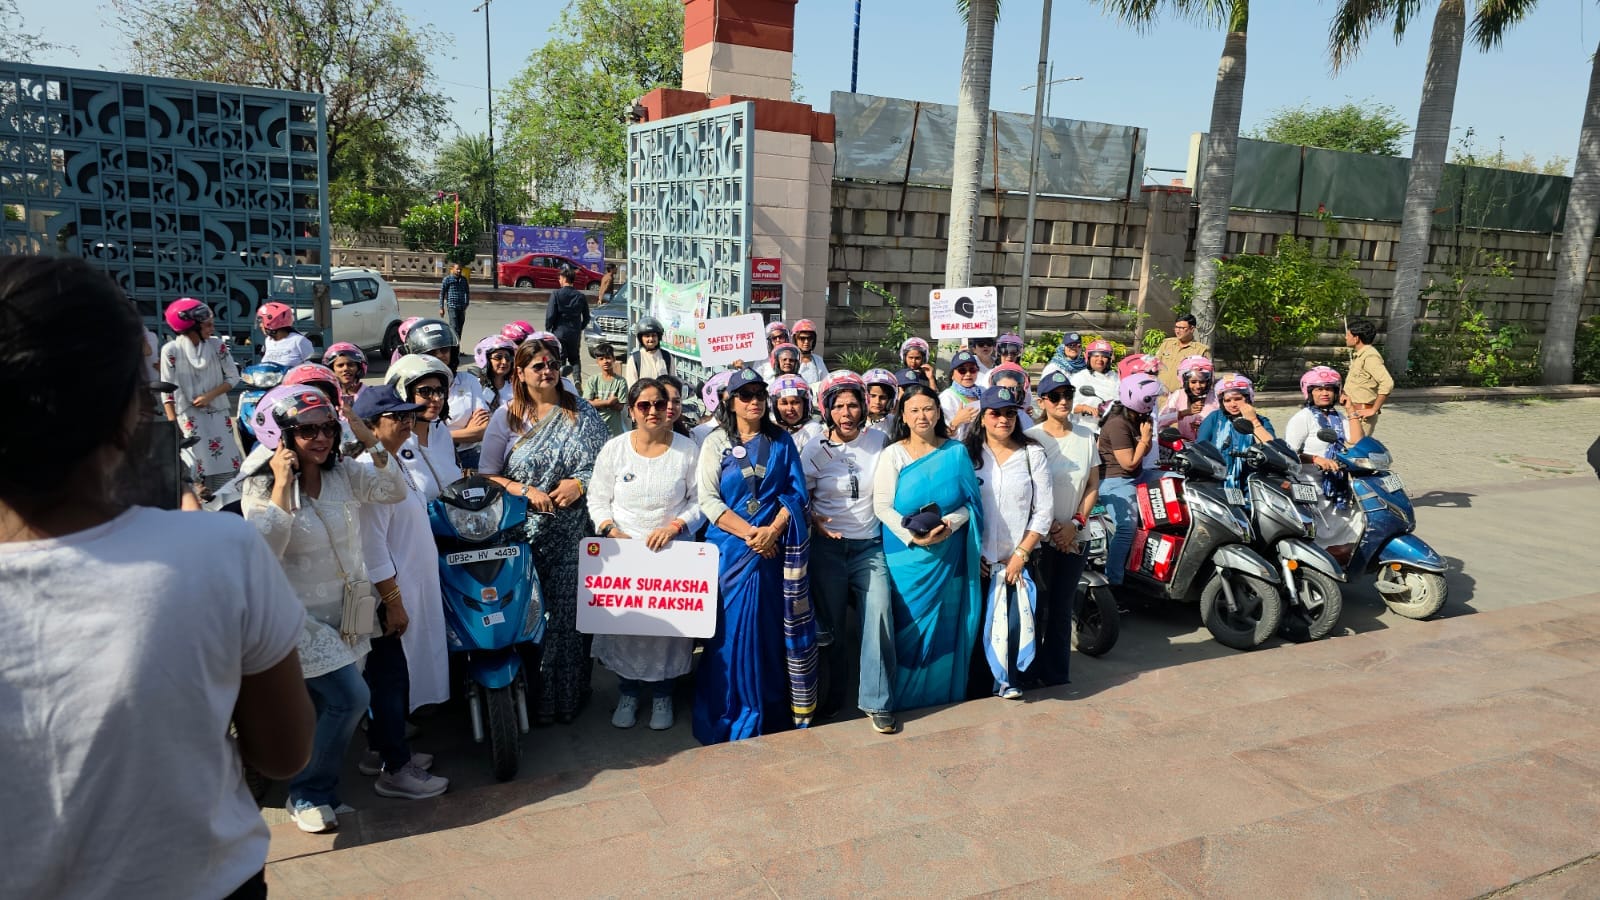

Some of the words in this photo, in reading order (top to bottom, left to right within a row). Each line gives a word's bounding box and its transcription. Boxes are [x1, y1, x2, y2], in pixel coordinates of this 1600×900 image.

[962, 322, 987, 330] HELMET
[707, 335, 733, 344] SAFETY
[735, 332, 754, 340] FIRST
[712, 344, 733, 352] SPEED
[735, 341, 753, 349] LAST
[1149, 488, 1167, 519] STUDDS
[478, 551, 489, 560] HV
[585, 576, 632, 589] SADAK
[637, 578, 709, 593] SURAKSHA
[588, 595, 643, 608] JEEVAN
[648, 596, 704, 611] RAKSHA
